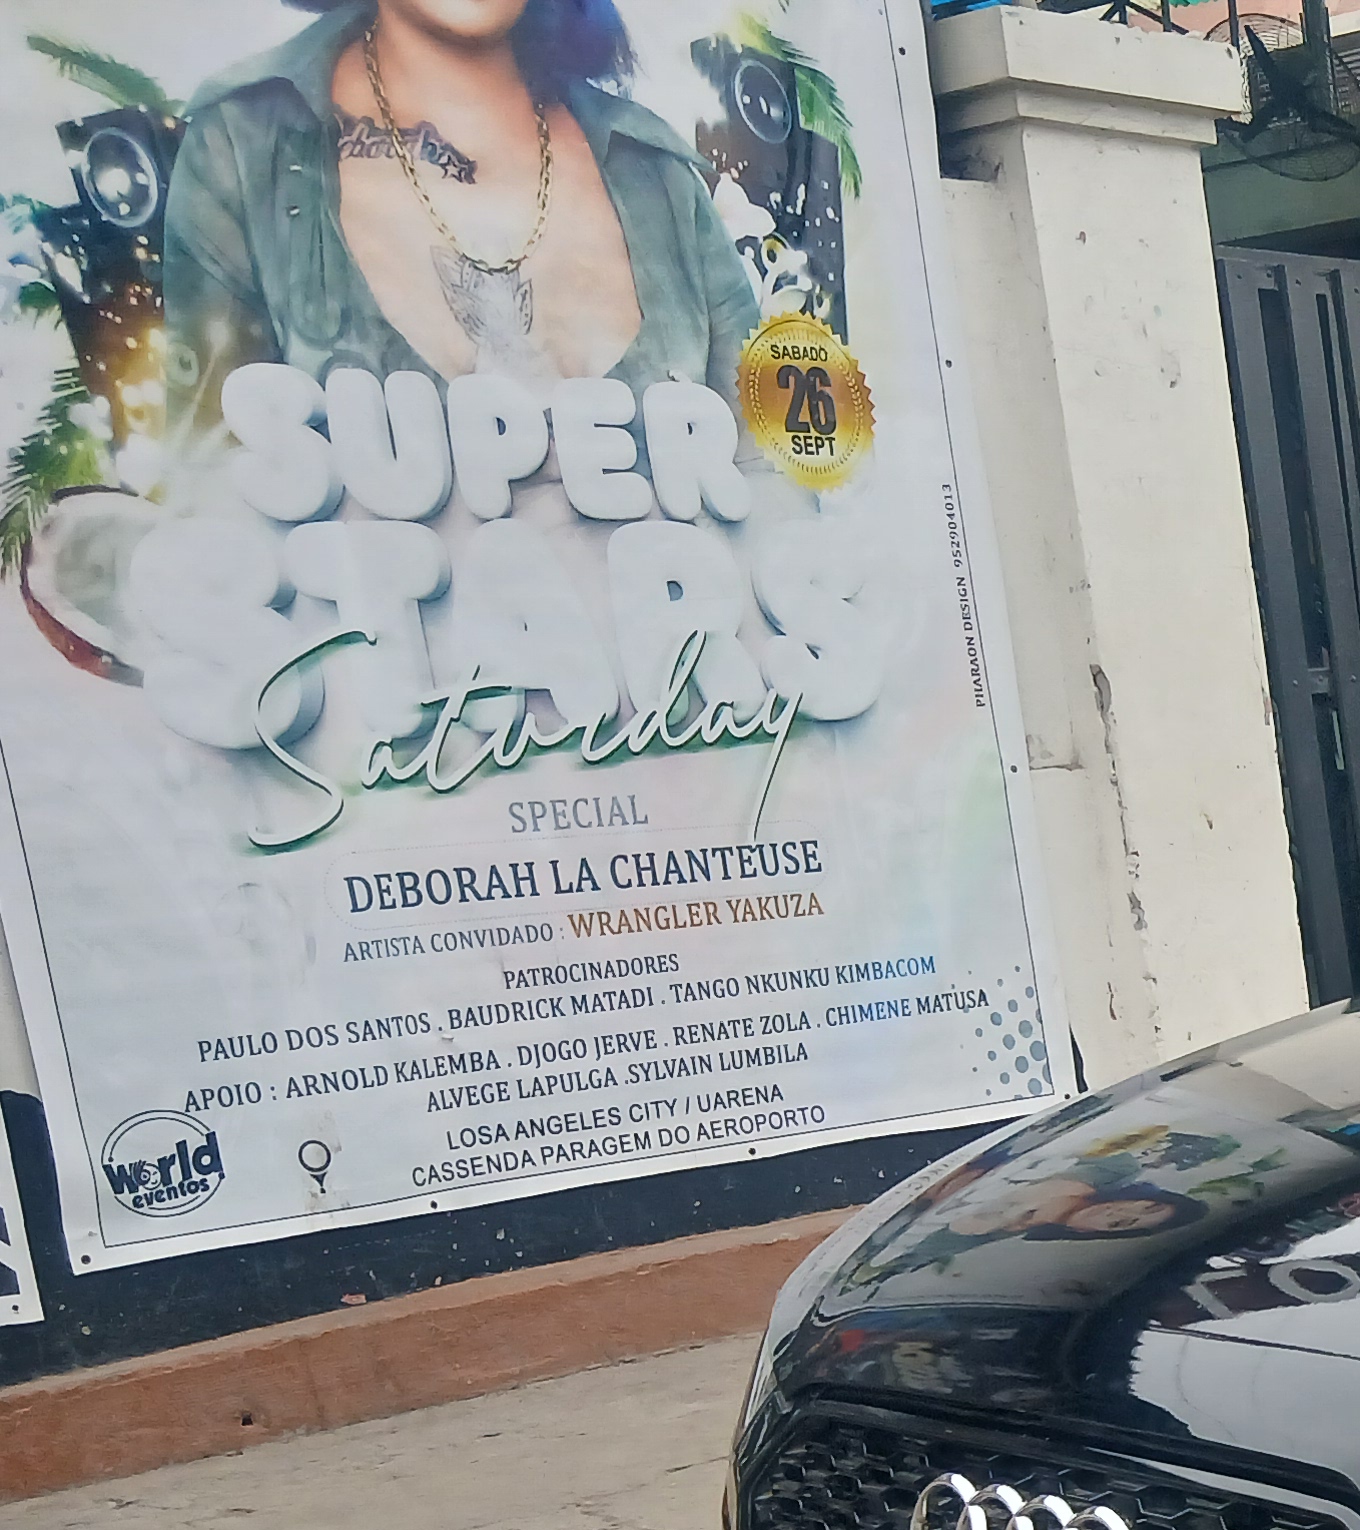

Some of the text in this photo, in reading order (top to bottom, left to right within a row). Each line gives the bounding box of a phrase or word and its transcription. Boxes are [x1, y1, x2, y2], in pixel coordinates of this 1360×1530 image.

[777, 365, 837, 435] 26
[222, 362, 752, 524] SUPER
[791, 435, 836, 456] SEPT
[941, 484, 986, 708] PHARAON DESIGN 952904013
[130, 518, 884, 750] STARS
[248, 629, 805, 849] Saturday
[508, 794, 649, 834] SPECIAL
[343, 840, 823, 913] DEBORAH LA CHANTEUSE
[343, 936, 425, 963] ARTISTA
[431, 924, 554, 952] CONVIDADO
[567, 899, 723, 939] WRANGLER
[726, 892, 824, 924] YAKUZA
[503, 953, 679, 990] PATROCINADORES
[197, 1031, 278, 1063] PAULO
[284, 1024, 339, 1051] DOS
[345, 1012, 431, 1044] SANTOS
[448, 997, 566, 1030] BAUDRICK
[570, 987, 654, 1016] MATADI
[669, 977, 740, 1004] TANGO
[745, 967, 831, 995] NKUNKU
[835, 955, 936, 985] KIMBACOM
[184, 1081, 262, 1113] APOIO
[286, 1065, 389, 1099] ARNOLD
[394, 1050, 501, 1084] KALEMBA
[517, 1038, 587, 1068] DJOGO
[594, 1029, 658, 1061] JERVE
[673, 1016, 755, 1046] RENATE
[759, 1010, 812, 1035] ZOLA
[825, 998, 912, 1027] CHIMENE
[915, 989, 990, 1015] MATUSA
[426, 1081, 510, 1112] ALVEGE
[516, 1067, 618, 1099] LAPULGA
[719, 1042, 809, 1072] LUMBILA
[412, 1105, 826, 1188] CASSENDA PARAGEM DO AEROPORTO
[446, 1125, 512, 1151] LOSA
[514, 1106, 622, 1140] ANGELES
[629, 1098, 677, 1123] CITY
[696, 1083, 784, 1113] UARENA
[132, 1177, 211, 1209] eventos
